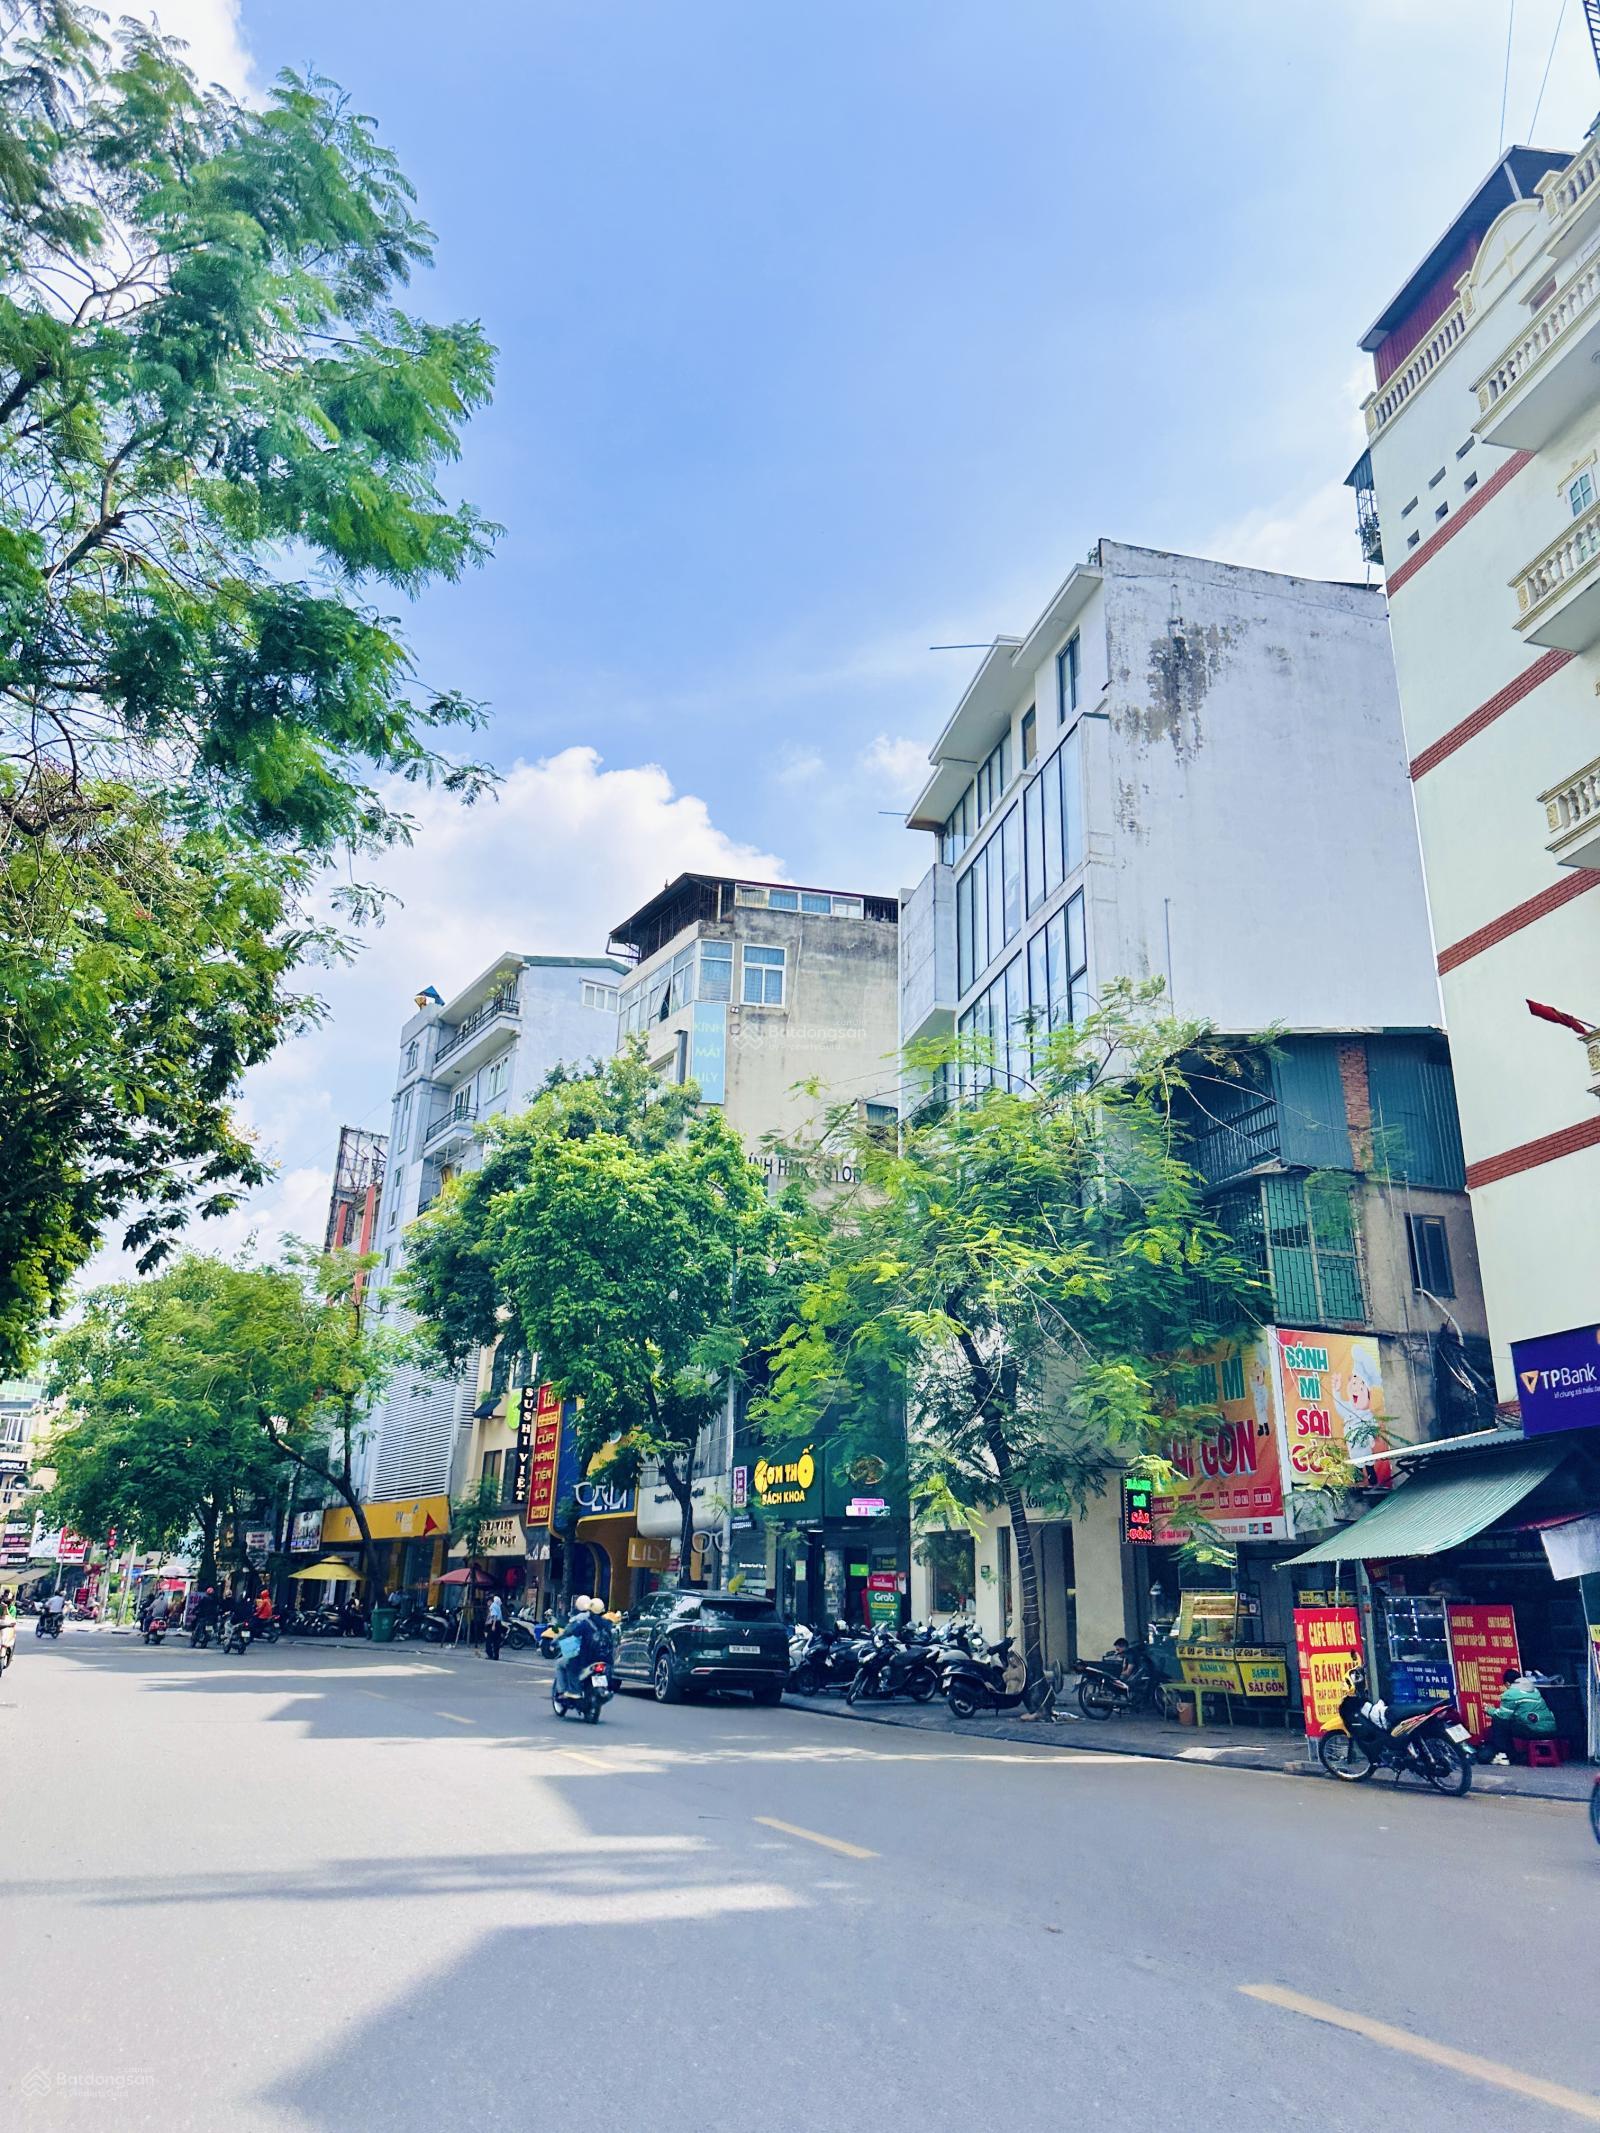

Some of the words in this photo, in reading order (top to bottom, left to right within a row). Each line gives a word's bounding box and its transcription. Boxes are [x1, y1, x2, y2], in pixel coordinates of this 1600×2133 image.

[748, 1152, 773, 1175] ÍNH
[1285, 1342, 1329, 1372] BÁNH
[1298, 1372, 1321, 1400] MÌ
[1540, 1362, 1598, 1390] TPBank
[520, 1387, 534, 1446] SUSHI
[1296, 1402, 1332, 1438] SÀI
[537, 1431, 555, 1445] CỬA
[1290, 1439, 1324, 1473] GÒ
[515, 1453, 529, 1501] VIỆT
[761, 1490, 782, 1505] BÁCH
[783, 1490, 805, 1503] KHOA
[631, 1543, 665, 1562] LILY
[874, 1592, 895, 1603] Grab
[1314, 1659, 1342, 1683] BÁNH
[1248, 1679, 1264, 1693] SÀI
[1264, 1678, 1285, 1693] GÒN
